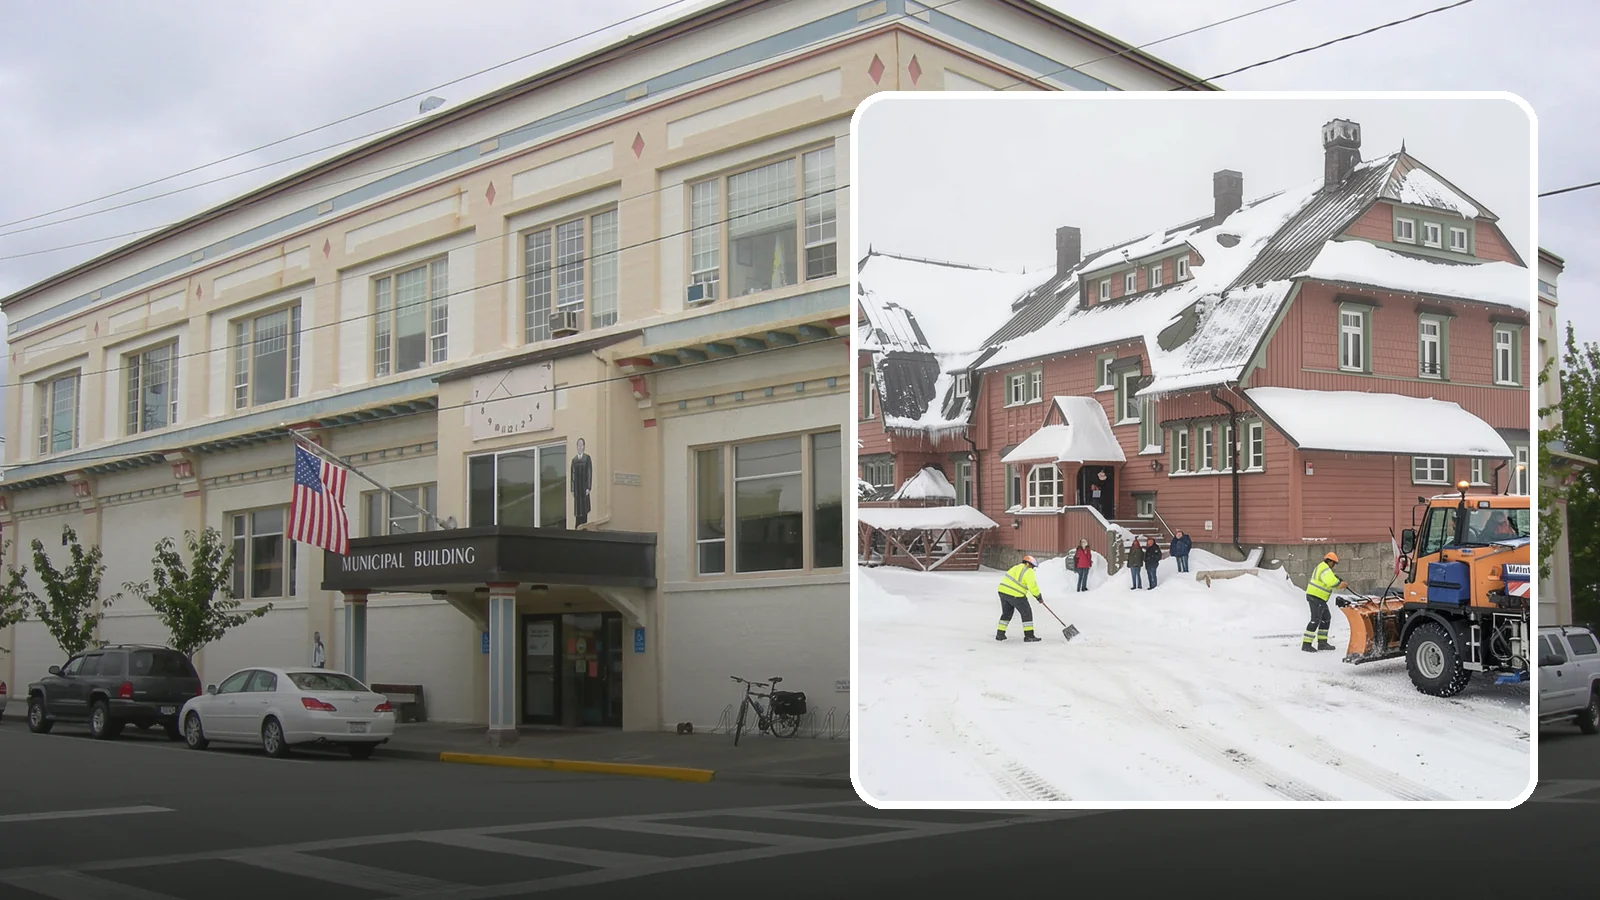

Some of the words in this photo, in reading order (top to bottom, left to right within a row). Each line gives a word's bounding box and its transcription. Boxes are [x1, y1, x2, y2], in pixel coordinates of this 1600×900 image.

[487, 417, 492, 426] 9
[501, 425, 506, 433] 11
[507, 425, 513, 433] 12
[521, 420, 526, 428] 2
[342, 552, 405, 572] MUNICIPAL
[414, 546, 475, 567] BUILDING
